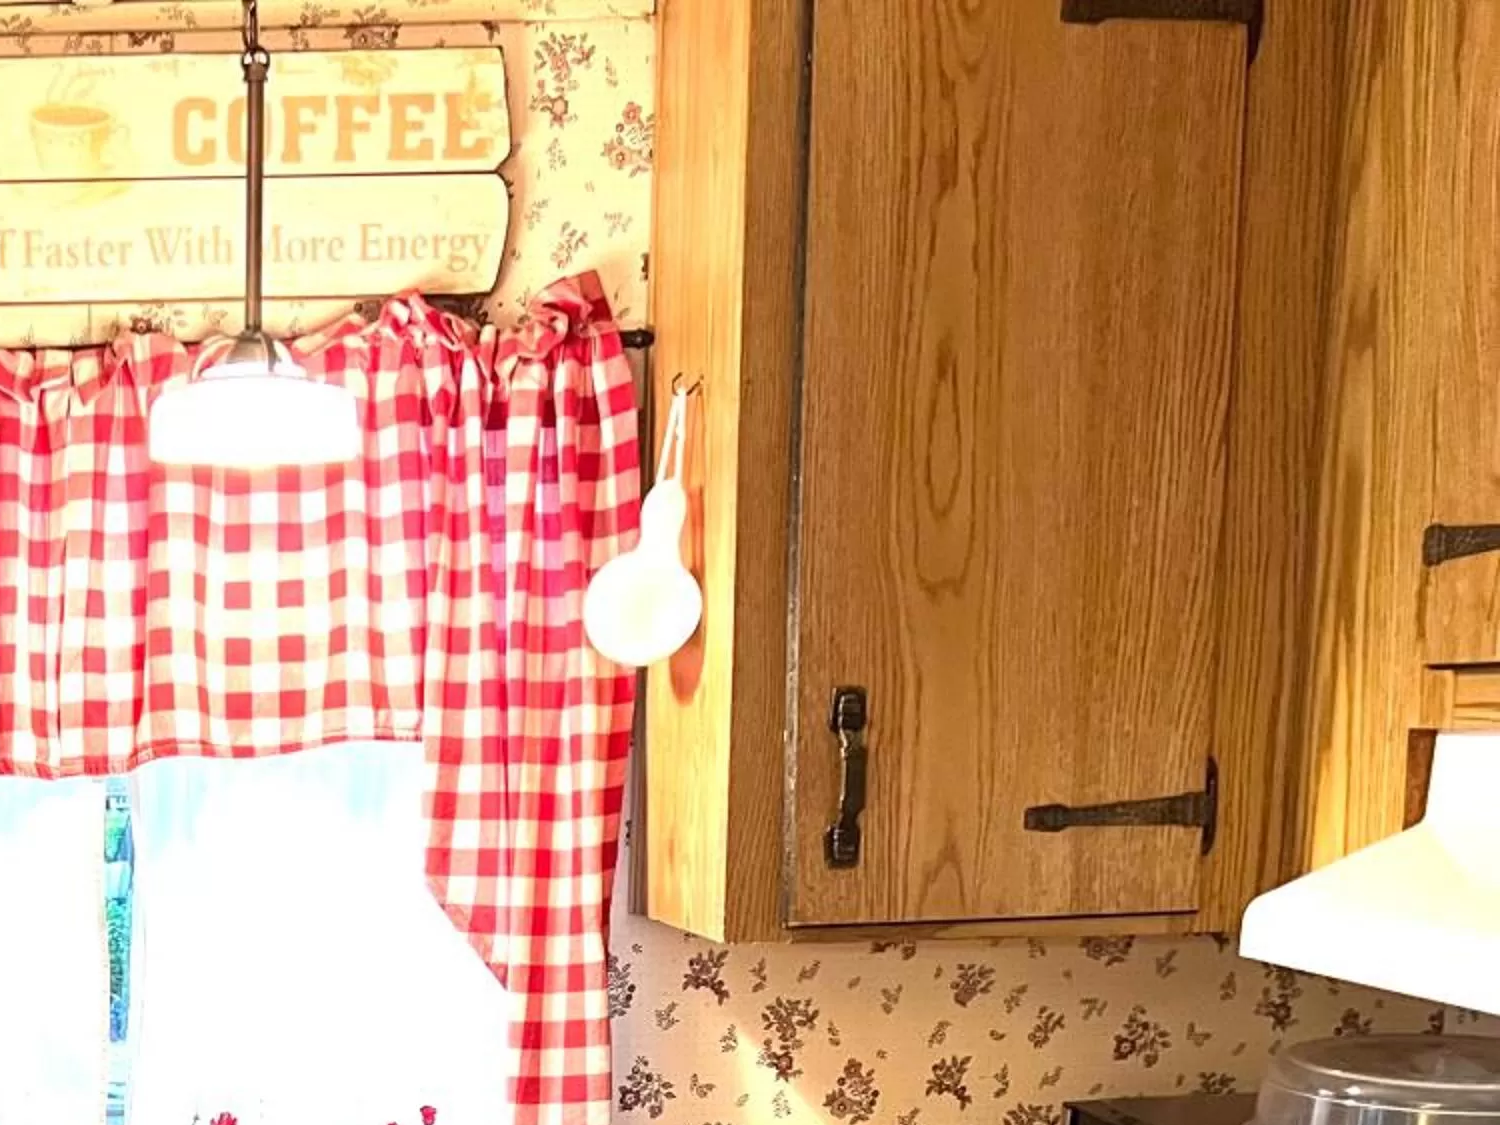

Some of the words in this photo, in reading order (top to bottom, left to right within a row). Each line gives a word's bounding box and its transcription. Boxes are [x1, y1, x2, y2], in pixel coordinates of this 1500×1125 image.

[171, 93, 494, 166] COFFEE
[22, 226, 133, 270] Faster
[145, 224, 233, 266] With
[358, 221, 491, 272] Energy
